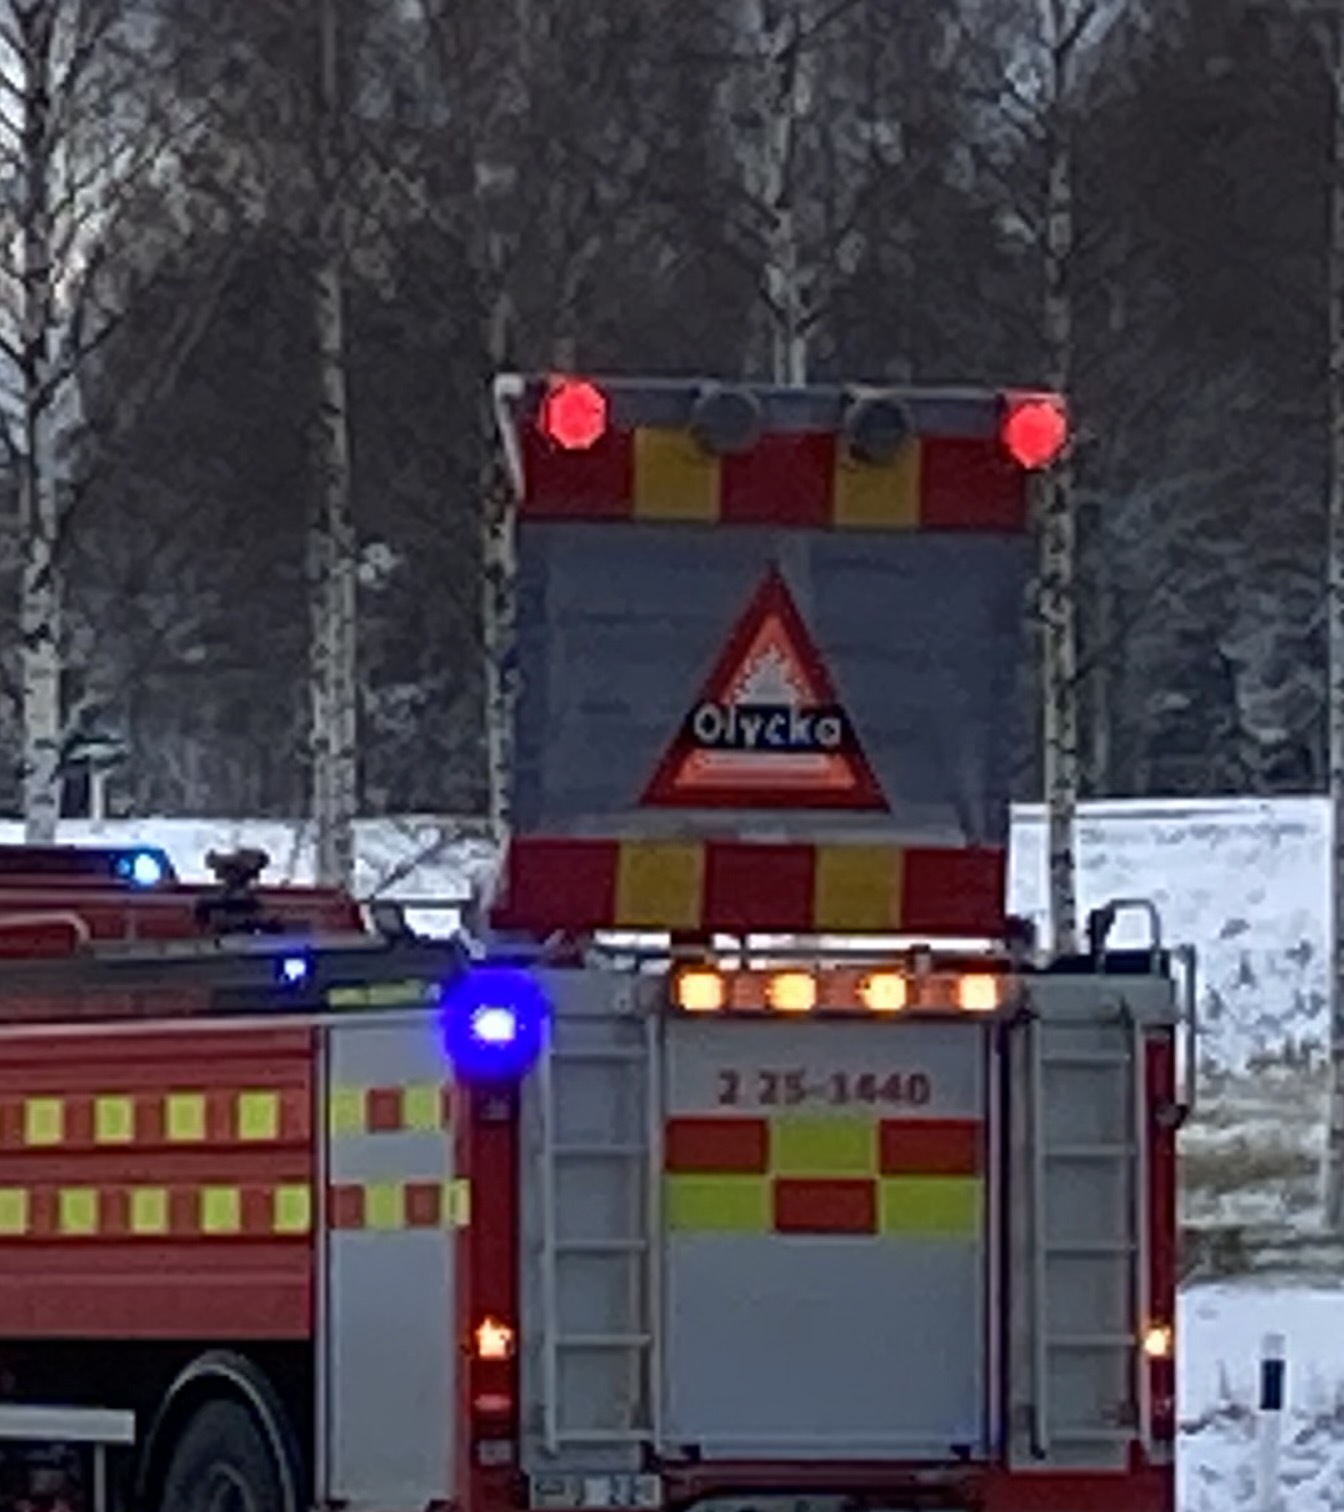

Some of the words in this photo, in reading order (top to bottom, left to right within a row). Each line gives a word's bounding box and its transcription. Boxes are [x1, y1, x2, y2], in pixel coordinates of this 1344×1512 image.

[693, 702, 842, 748] Olycka
[718, 1069, 740, 1105] 2
[758, 1069, 931, 1105] 25-1440
